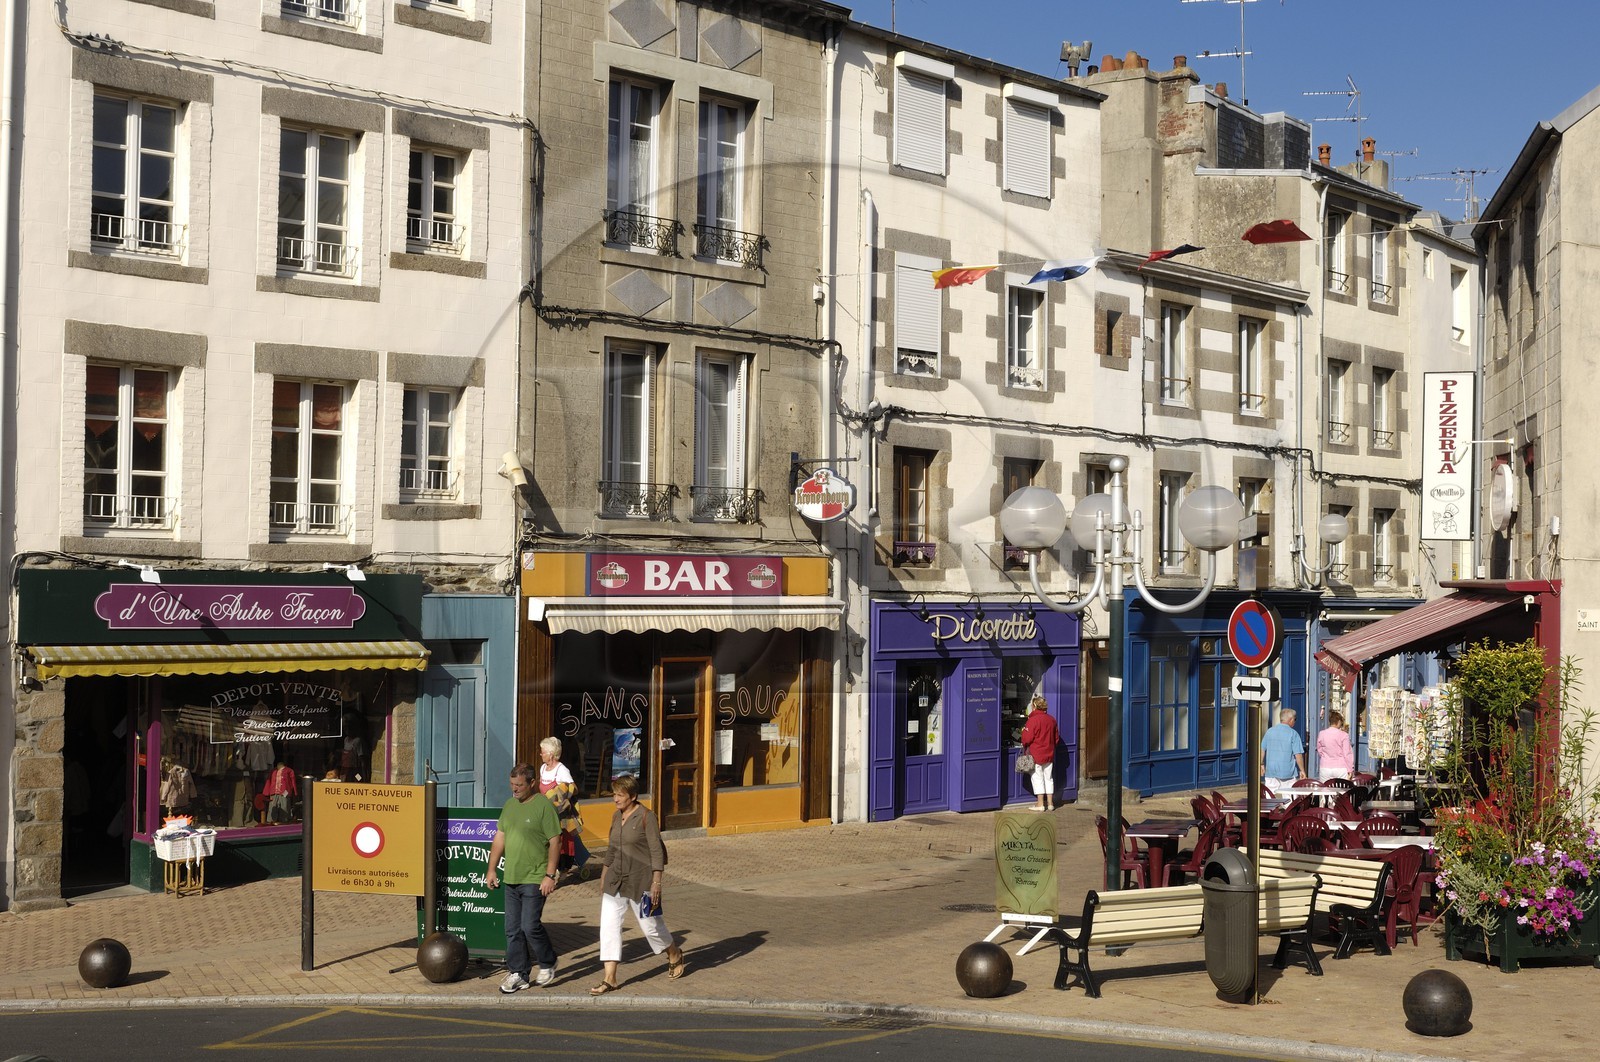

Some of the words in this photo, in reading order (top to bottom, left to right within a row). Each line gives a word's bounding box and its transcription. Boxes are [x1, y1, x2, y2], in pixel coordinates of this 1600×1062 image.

[1437, 380, 1458, 474] PIZZERIA
[796, 488, 849, 508] Kronenbourg
[644, 560, 733, 591] BAR
[209, 592, 274, 621] Autre
[280, 592, 345, 624] Façon
[925, 612, 1037, 645] Picorette
[211, 682, 342, 706] DEPOT-VENTE
[222, 706, 283, 717] Vêtements
[285, 704, 329, 717] Enfants
[556, 685, 649, 737] SANS
[242, 718, 312, 730] Puériculture
[233, 732, 273, 743] Future
[273, 730, 320, 741] Maman
[324, 787, 341, 796] RUE
[343, 788, 413, 798] SAINT-SAUVEUR
[336, 802, 356, 811] VOIE
[358, 803, 400, 812] PIETONNE
[475, 822, 497, 838] Faço
[327, 867, 367, 876] Livraisons
[368, 869, 409, 878] autorisées
[436, 872, 468, 883] êtements
[341, 878, 351, 886] de
[353, 879, 375, 887] 6h30
[377, 880, 382, 888] à
[384, 880, 395, 888] 9h
[441, 887, 488, 899] Puériculture
[462, 901, 495, 913] Maman
